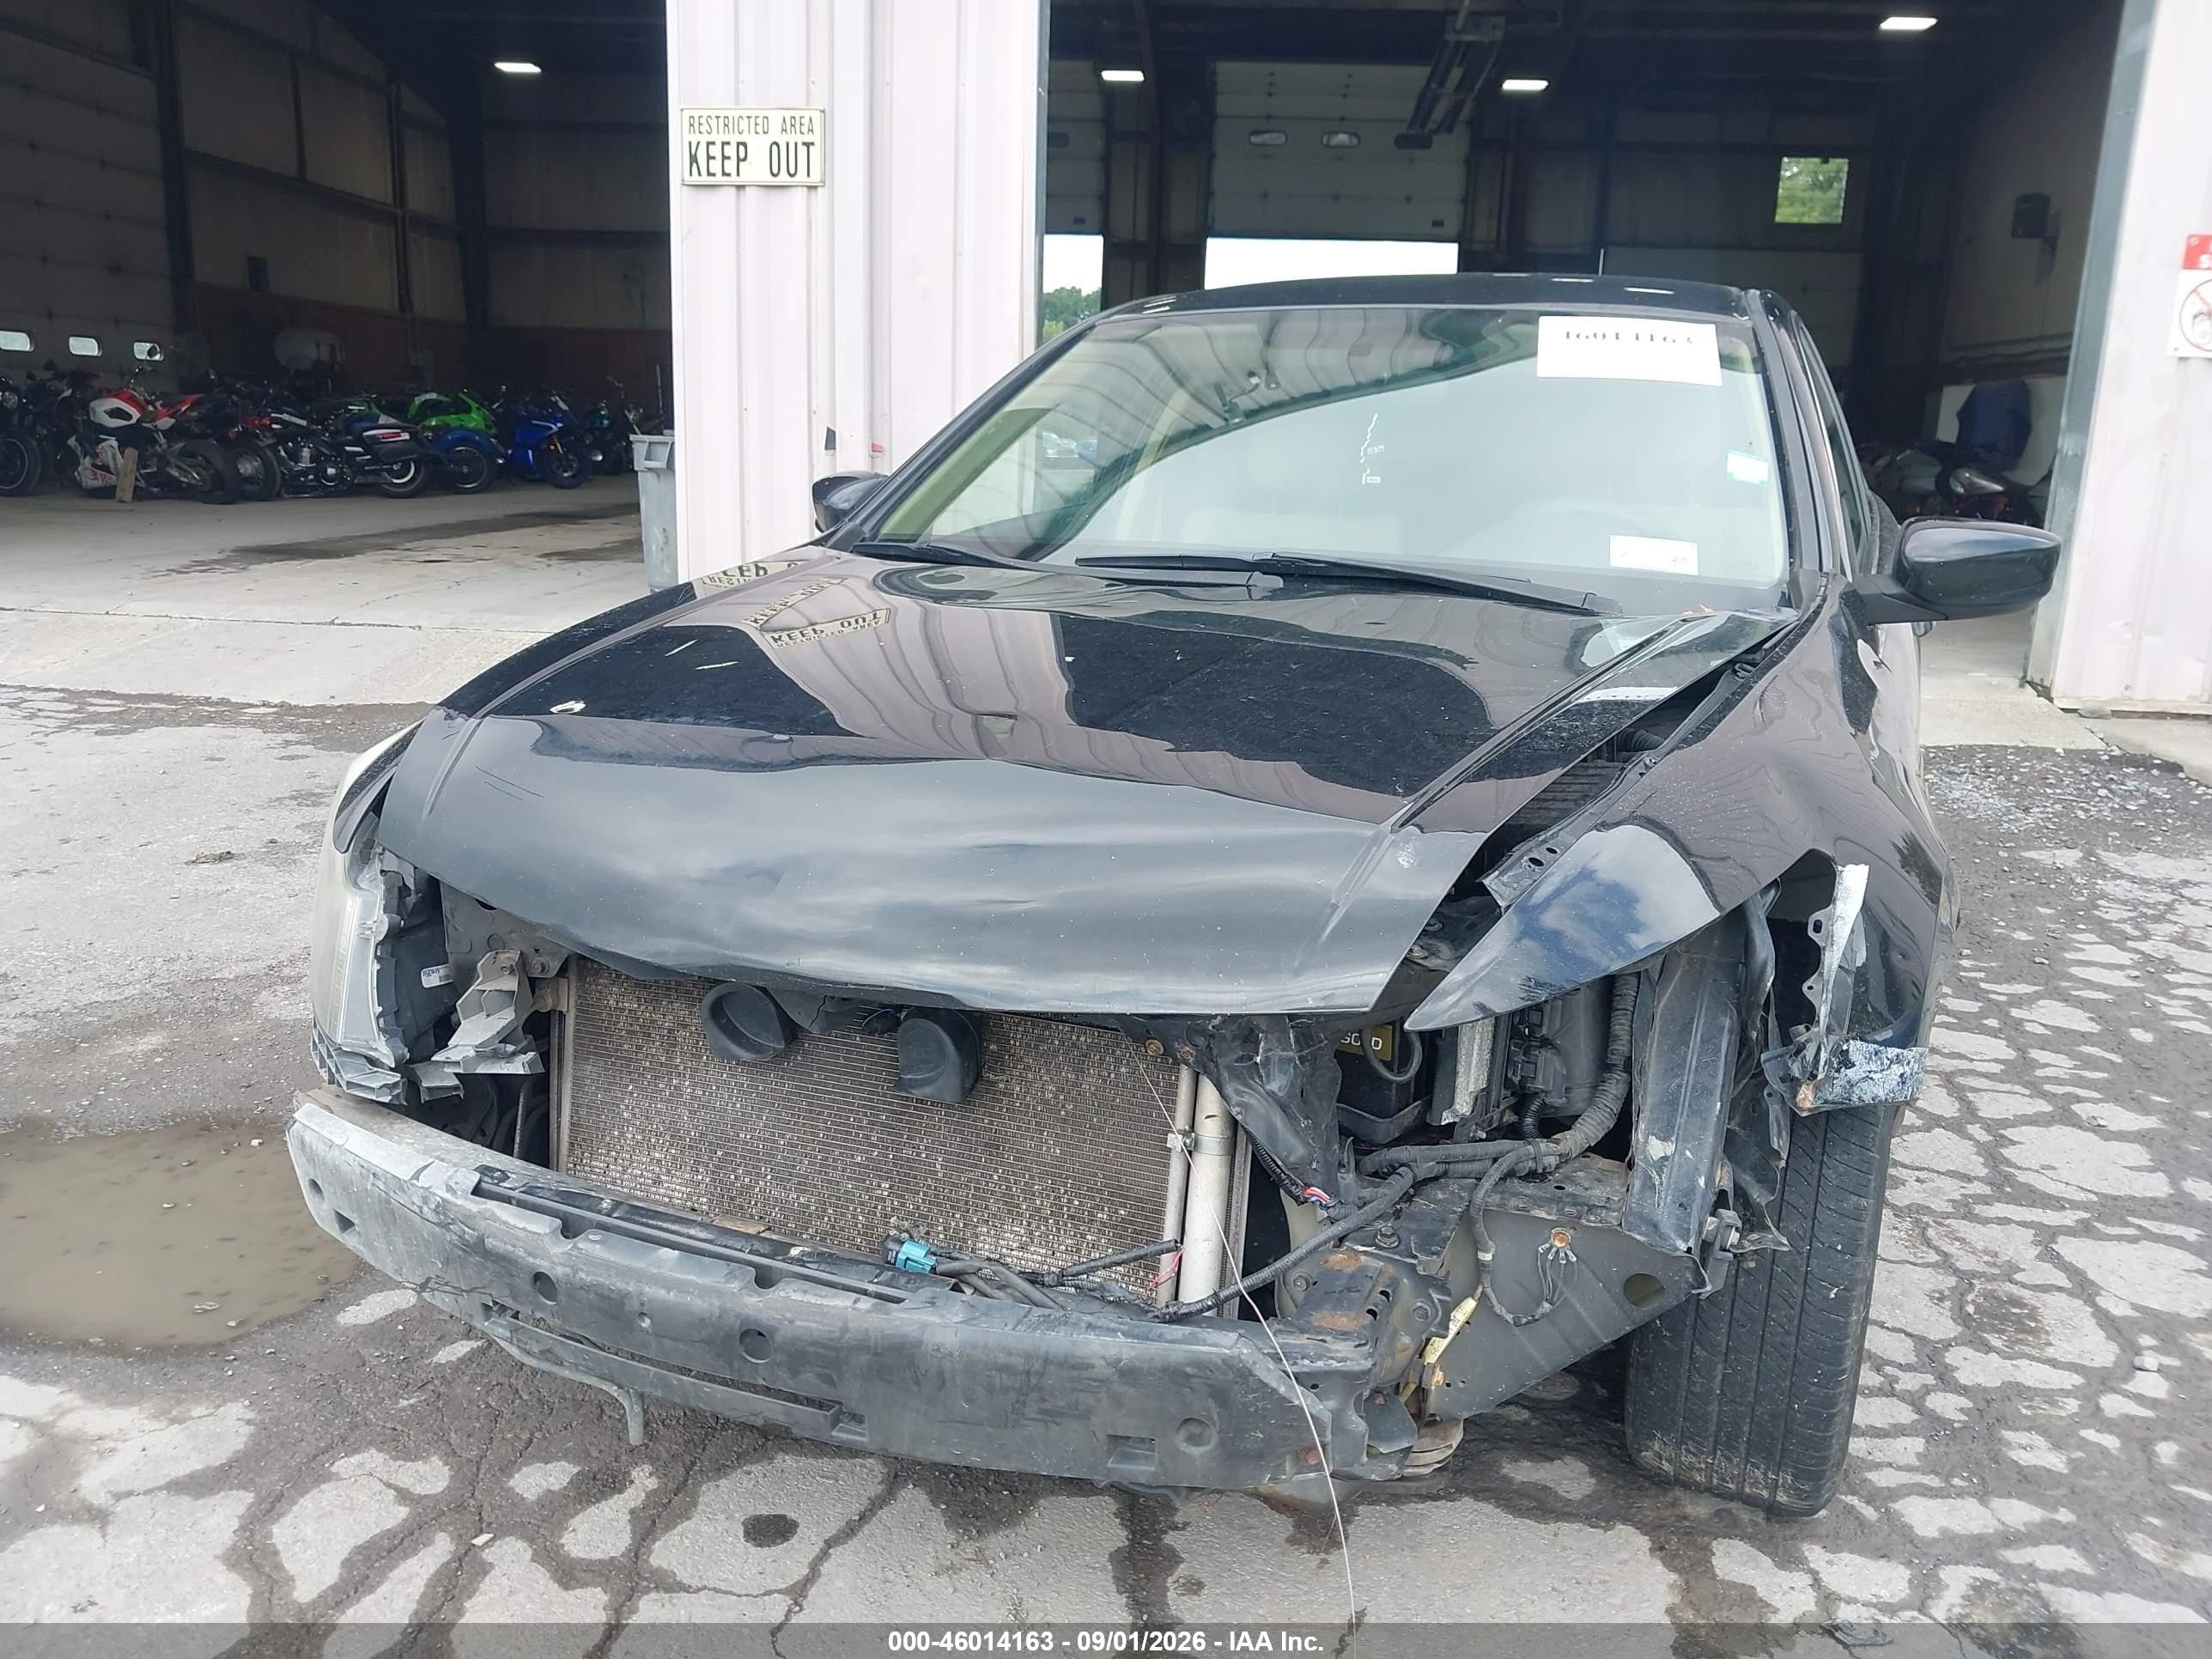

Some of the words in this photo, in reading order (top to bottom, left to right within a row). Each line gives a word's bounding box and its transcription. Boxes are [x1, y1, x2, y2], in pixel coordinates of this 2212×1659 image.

[688, 115, 769, 135] RESTRICTED
[781, 115, 815, 135] AREA
[688, 140, 748, 177] KEEP
[769, 140, 815, 179] OUT
